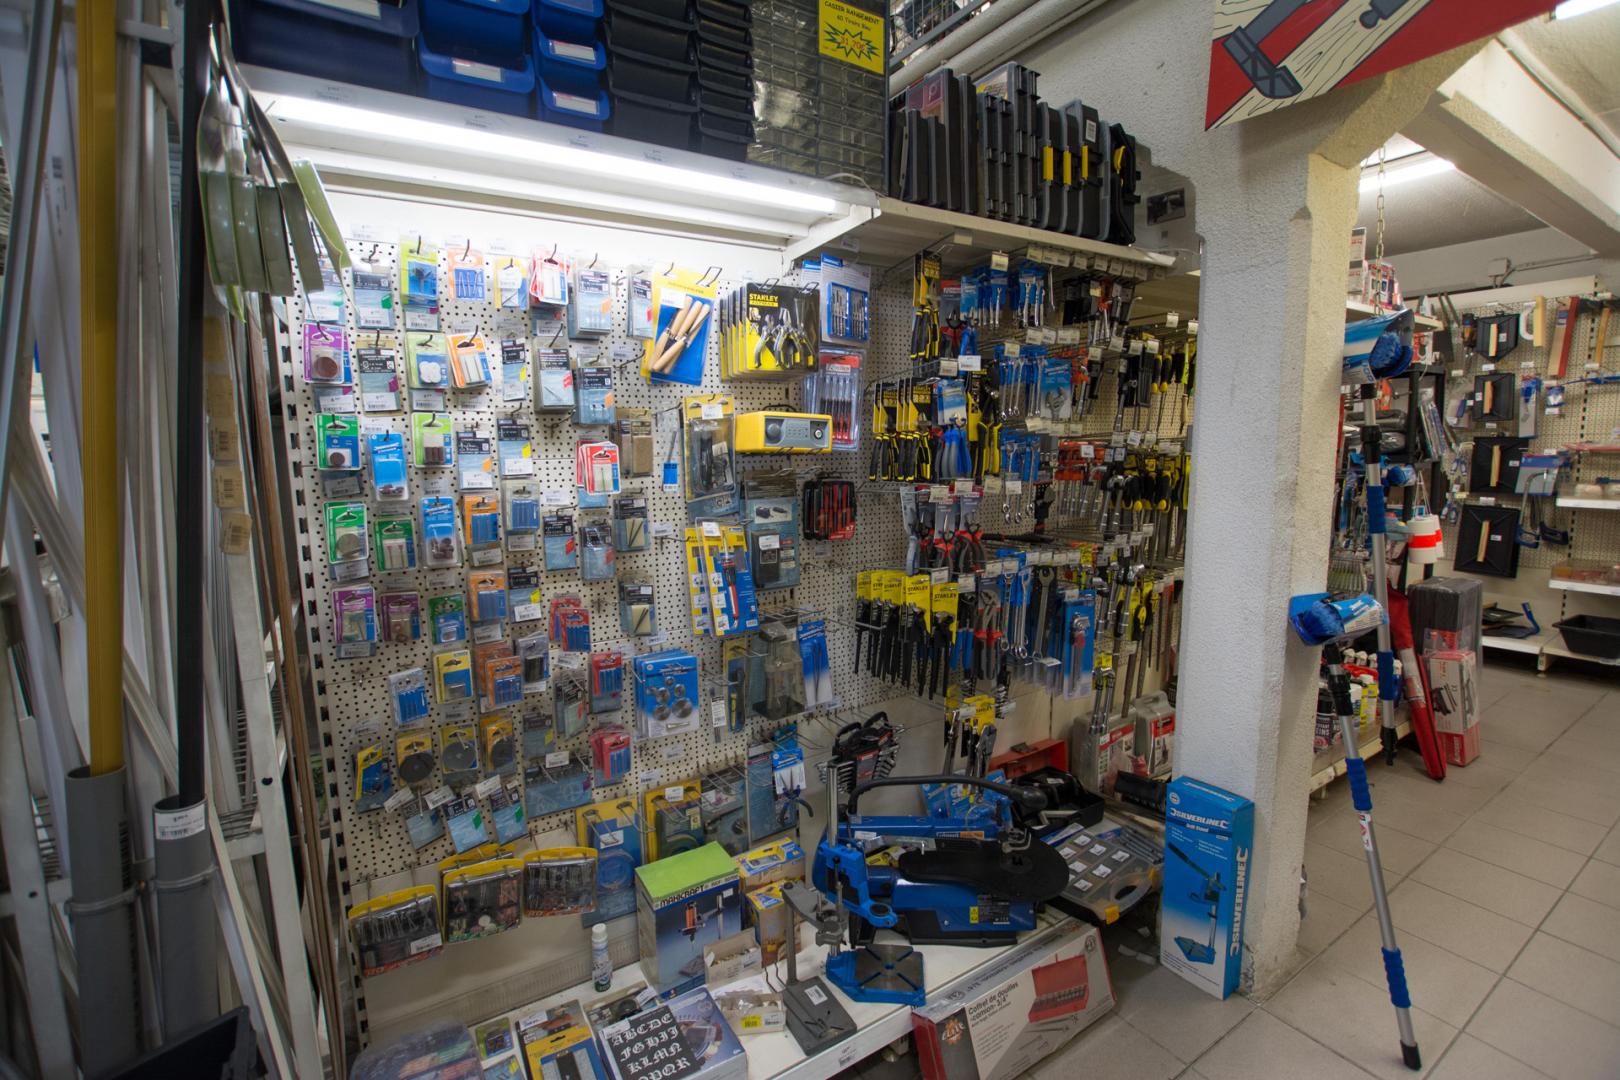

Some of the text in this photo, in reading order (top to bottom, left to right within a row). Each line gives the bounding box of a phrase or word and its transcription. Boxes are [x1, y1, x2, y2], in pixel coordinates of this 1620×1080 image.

[749, 293, 779, 302] STANLEY
[1172, 809, 1227, 829] SILVERLINE
[1231, 850, 1248, 951] SILVERLINE
[968, 998, 988, 1015] Coffret
[989, 994, 997, 1003] de
